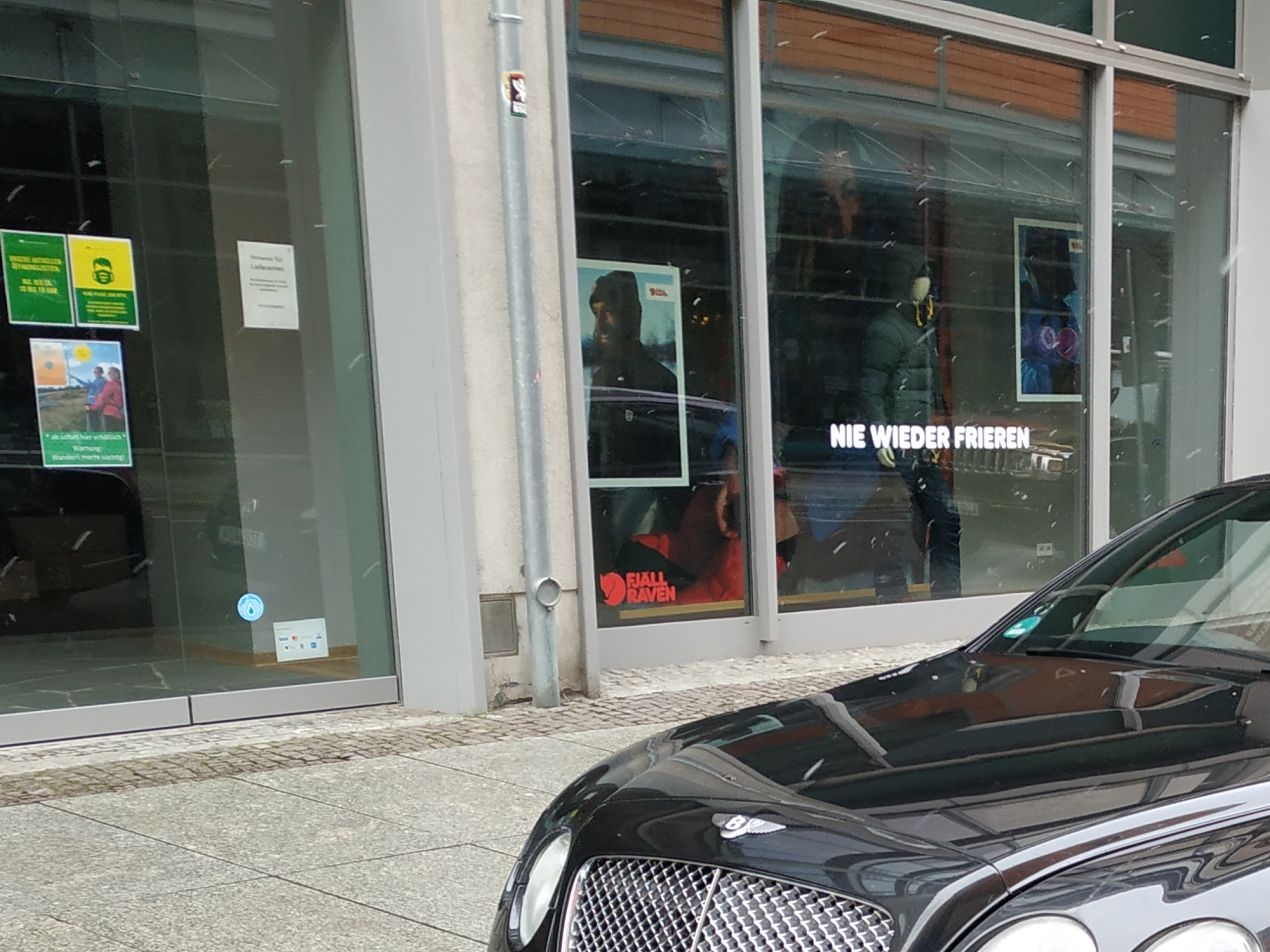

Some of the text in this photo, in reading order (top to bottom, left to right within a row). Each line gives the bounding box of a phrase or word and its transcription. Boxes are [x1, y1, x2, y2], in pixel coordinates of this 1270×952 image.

[830, 423, 1030, 450] NIE WIEDER FRIEREN
